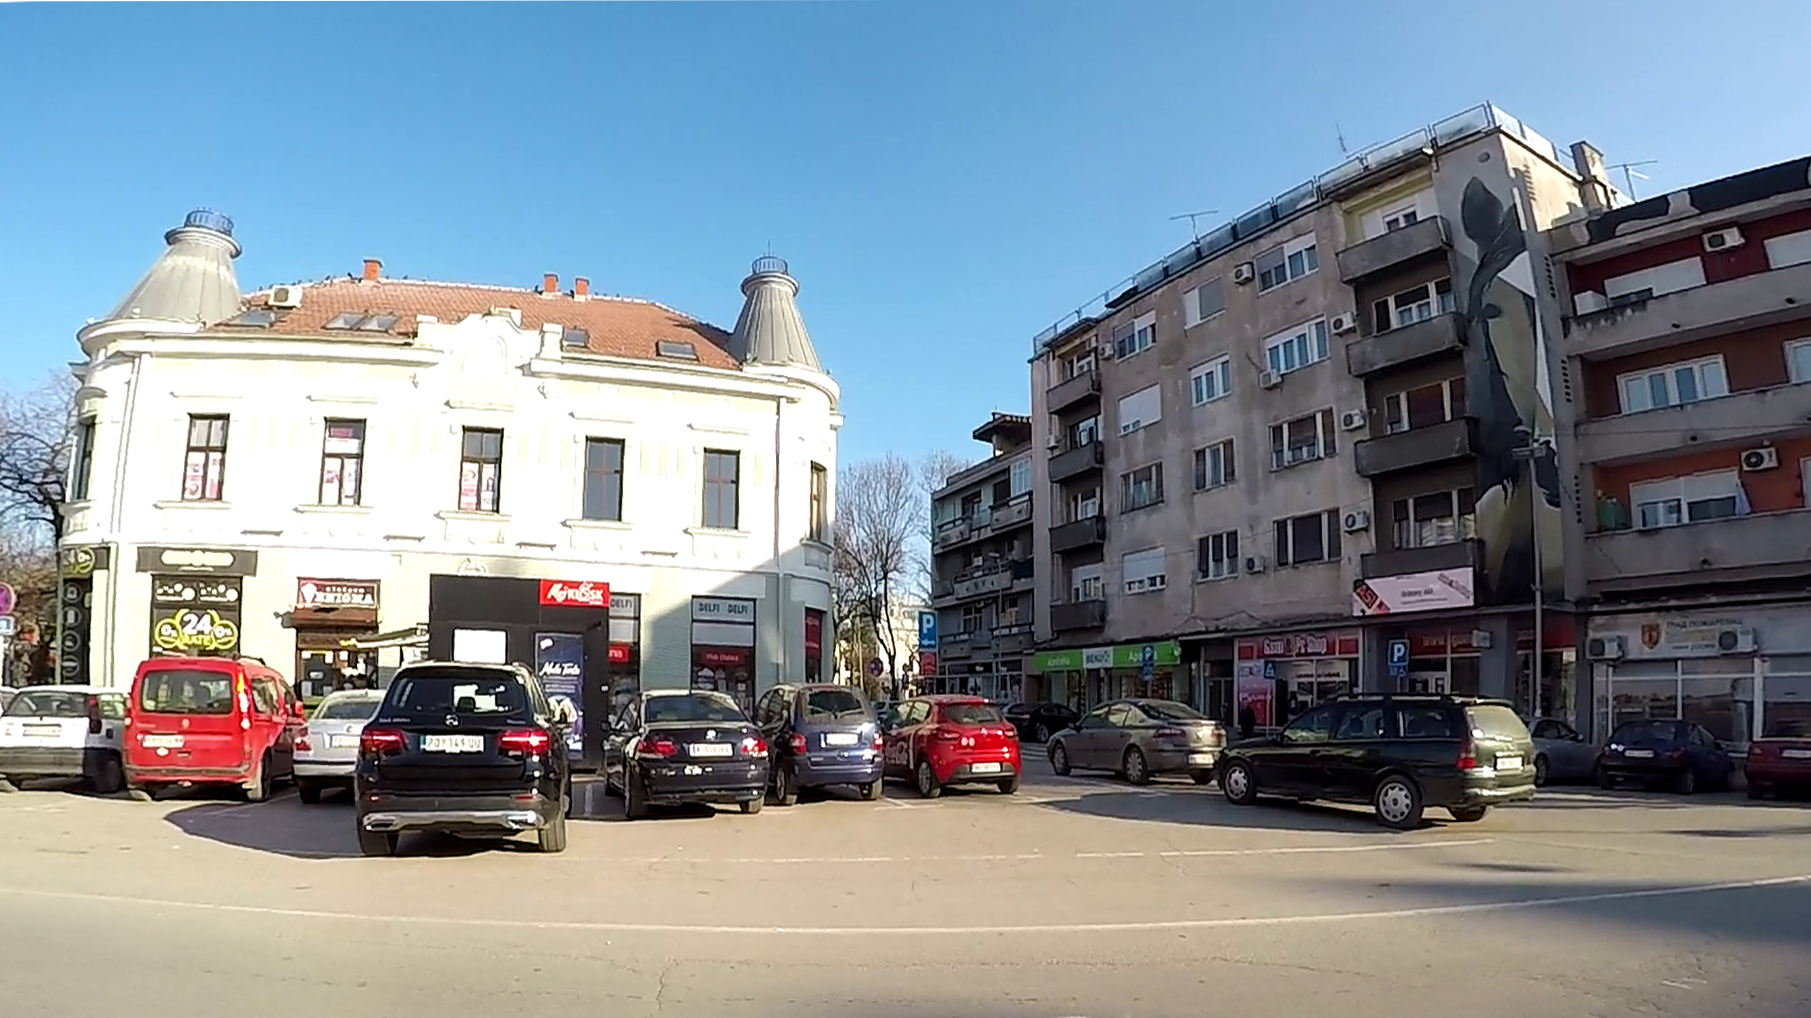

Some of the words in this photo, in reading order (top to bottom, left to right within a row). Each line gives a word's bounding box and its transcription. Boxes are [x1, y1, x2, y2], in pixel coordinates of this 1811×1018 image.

[609, 598, 633, 609] DELFI
[700, 602, 719, 612] DELFI
[728, 604, 748, 614] DELFI
[182, 613, 212, 635] 24
[922, 614, 934, 634] P
[1394, 643, 1405, 662] P
